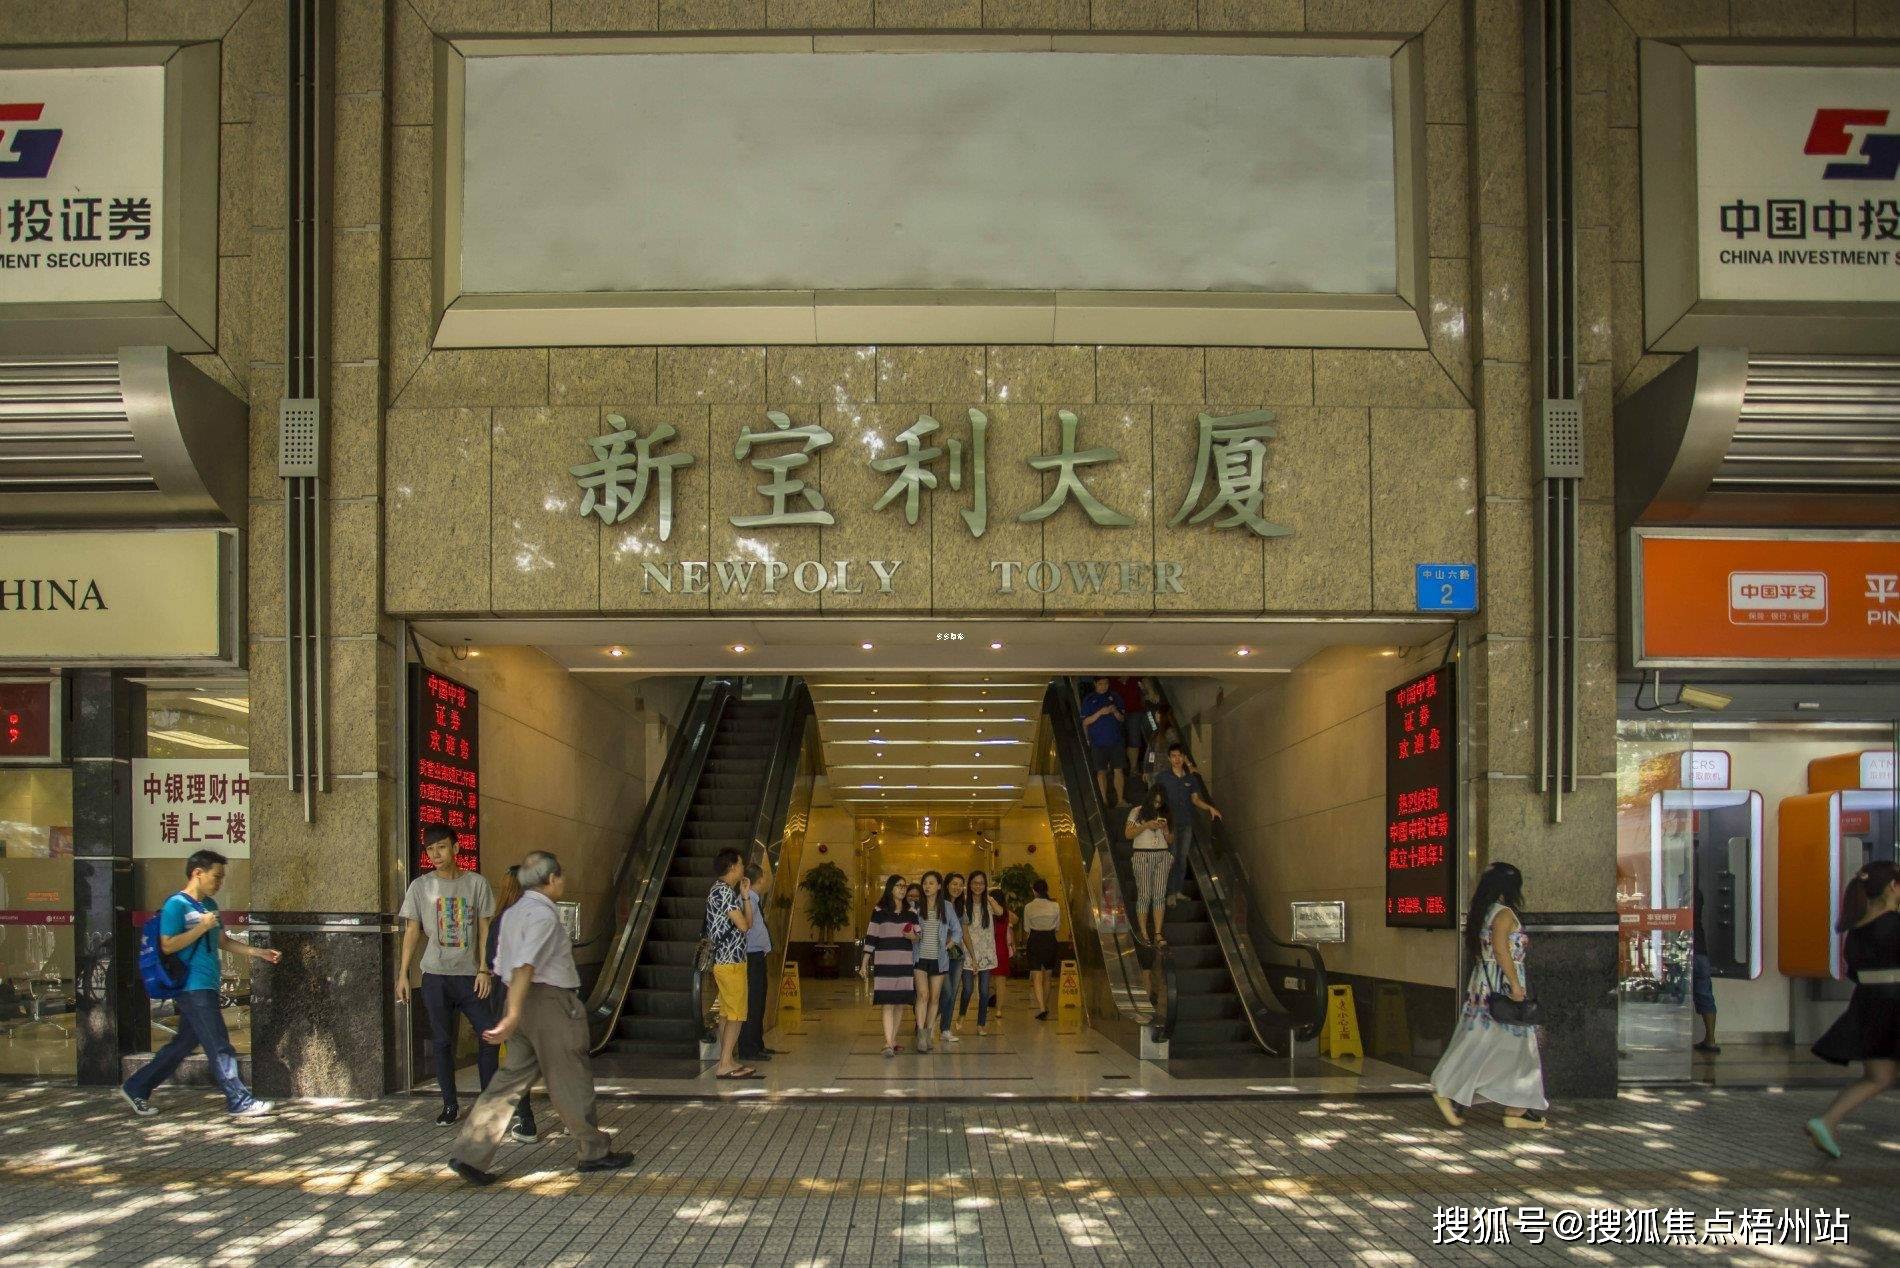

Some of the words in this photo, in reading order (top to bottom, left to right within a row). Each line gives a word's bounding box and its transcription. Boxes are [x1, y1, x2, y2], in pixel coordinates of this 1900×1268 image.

[0, 197, 151, 242] 投证券
[1720, 199, 1900, 240] 中国中投
[47, 251, 150, 268] SECURITIES
[1719, 250, 1774, 264] CHINA
[1778, 251, 1890, 265] INVESTMENT
[569, 408, 1294, 541] 新宝利大厦
[641, 560, 902, 595] NEWPOLY
[990, 560, 1187, 595] TOWER
[1423, 570, 1470, 580] 中山六路
[1865, 574, 1899, 603] 平
[0, 579, 108, 611] HINA
[1440, 583, 1453, 605] 2
[1741, 584, 1816, 599] 中国平安
[1867, 610, 1900, 626] PIN
[144, 773, 249, 804] 中银理财中
[160, 812, 245, 844] 请上二楼
